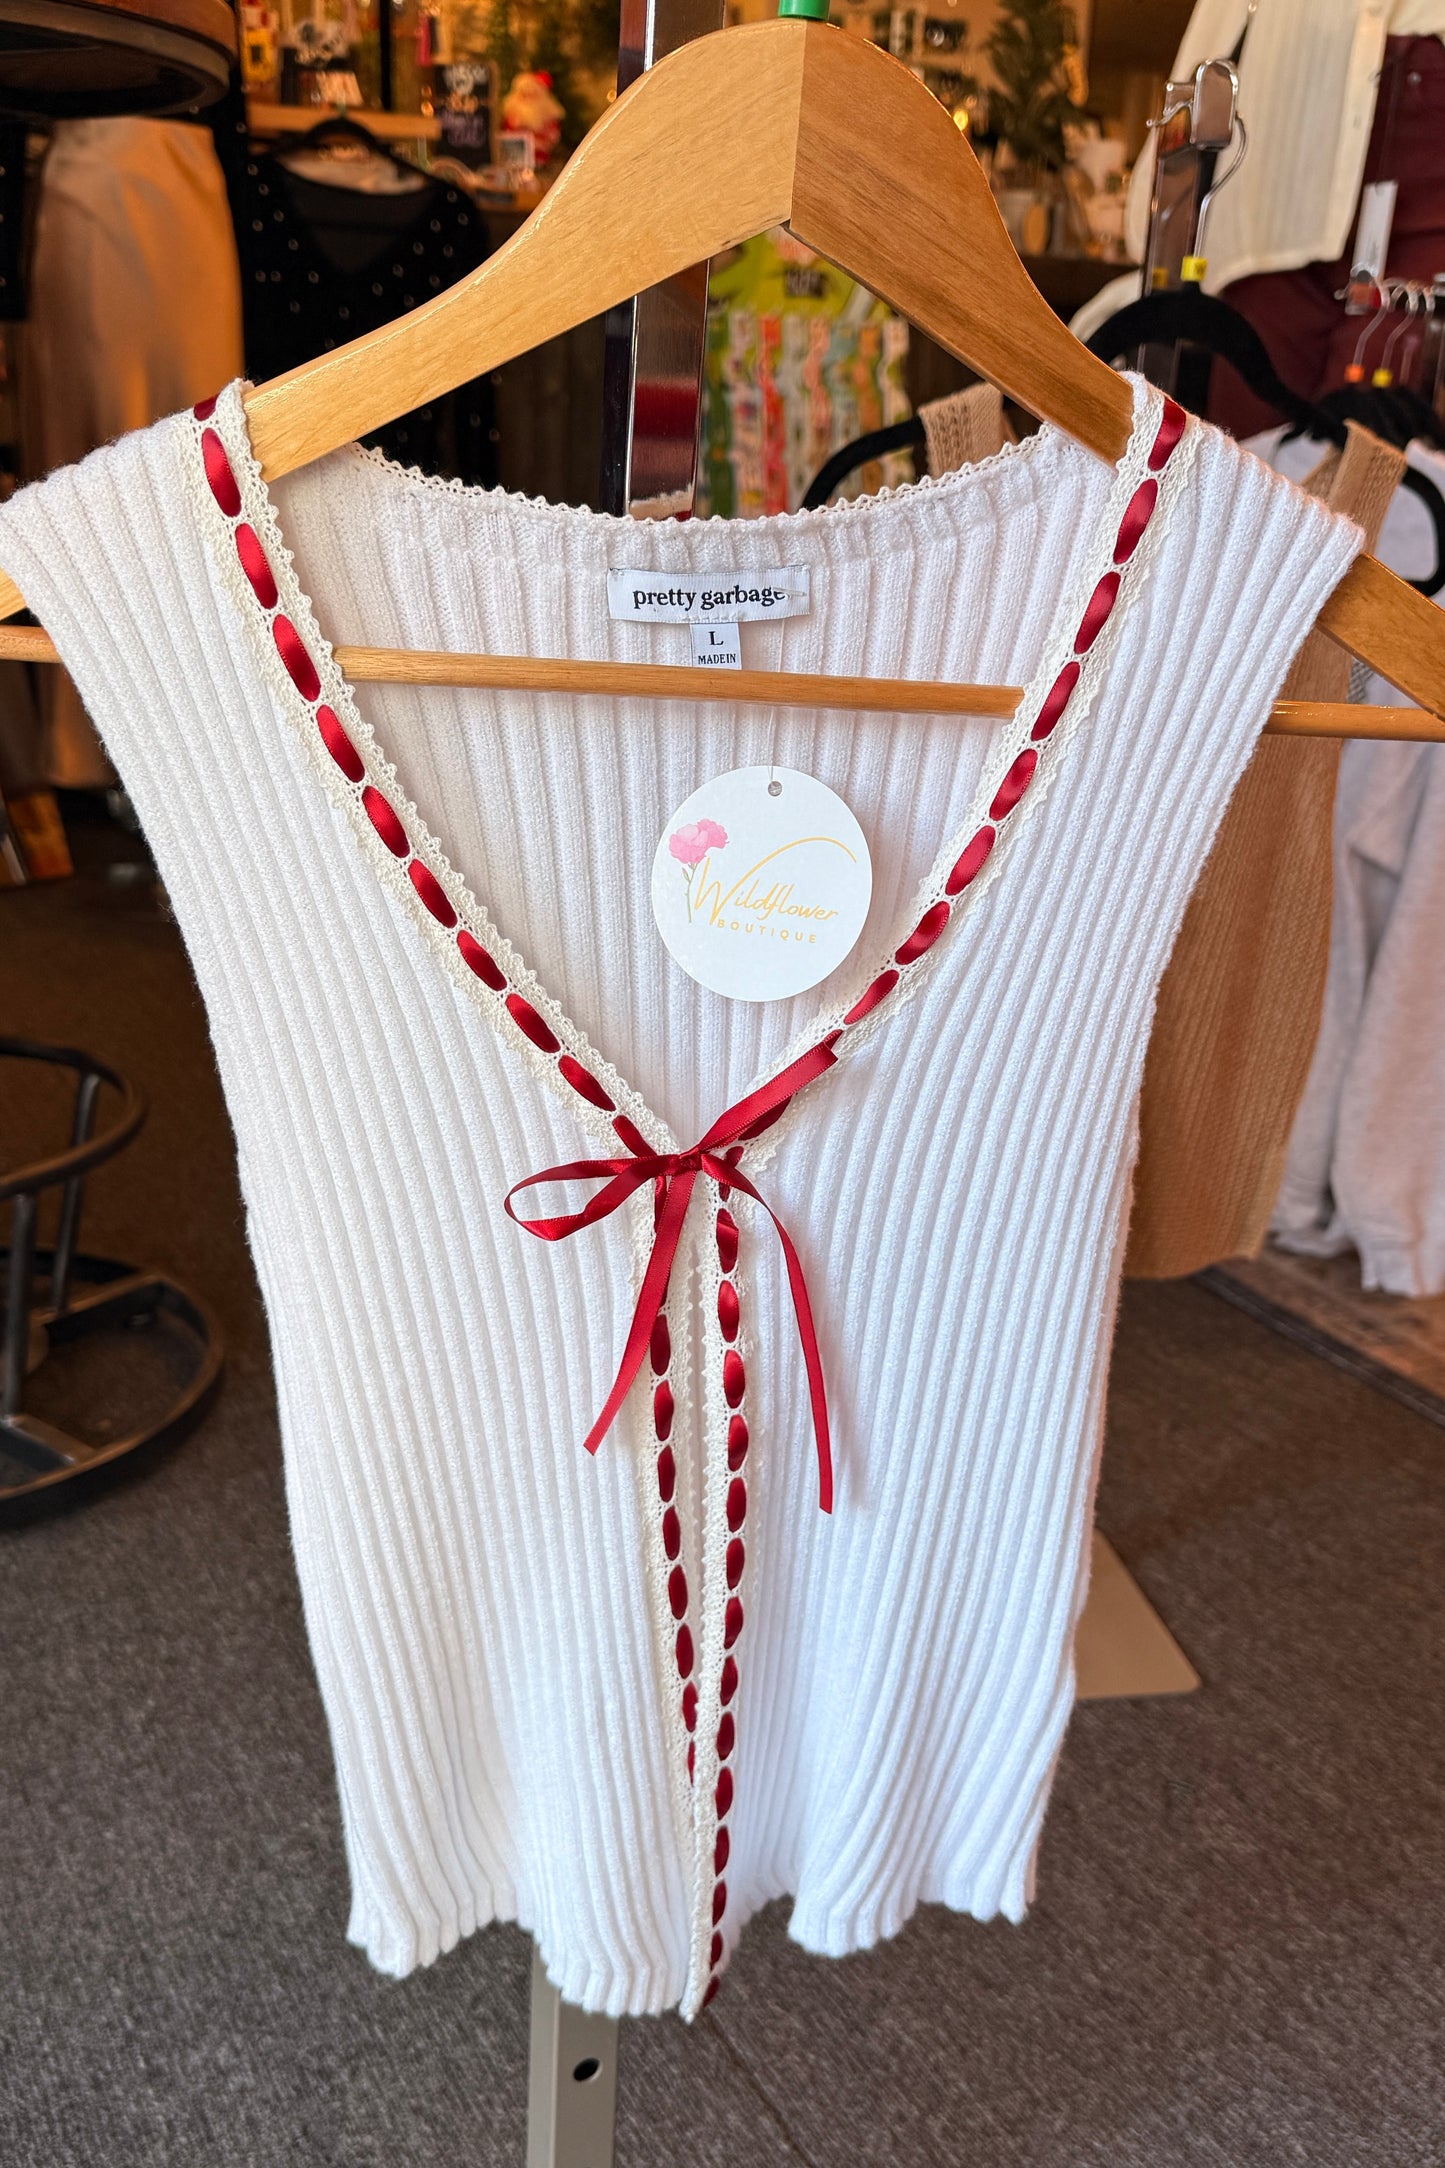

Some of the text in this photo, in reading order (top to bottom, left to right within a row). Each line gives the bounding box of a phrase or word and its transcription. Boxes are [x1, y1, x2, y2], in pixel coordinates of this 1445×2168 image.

[633, 585, 785, 611] pretty garbage
[709, 631, 724, 646] L
[694, 836, 857, 925] Wildflower
[717, 918, 817, 944] BOUTIQUE
